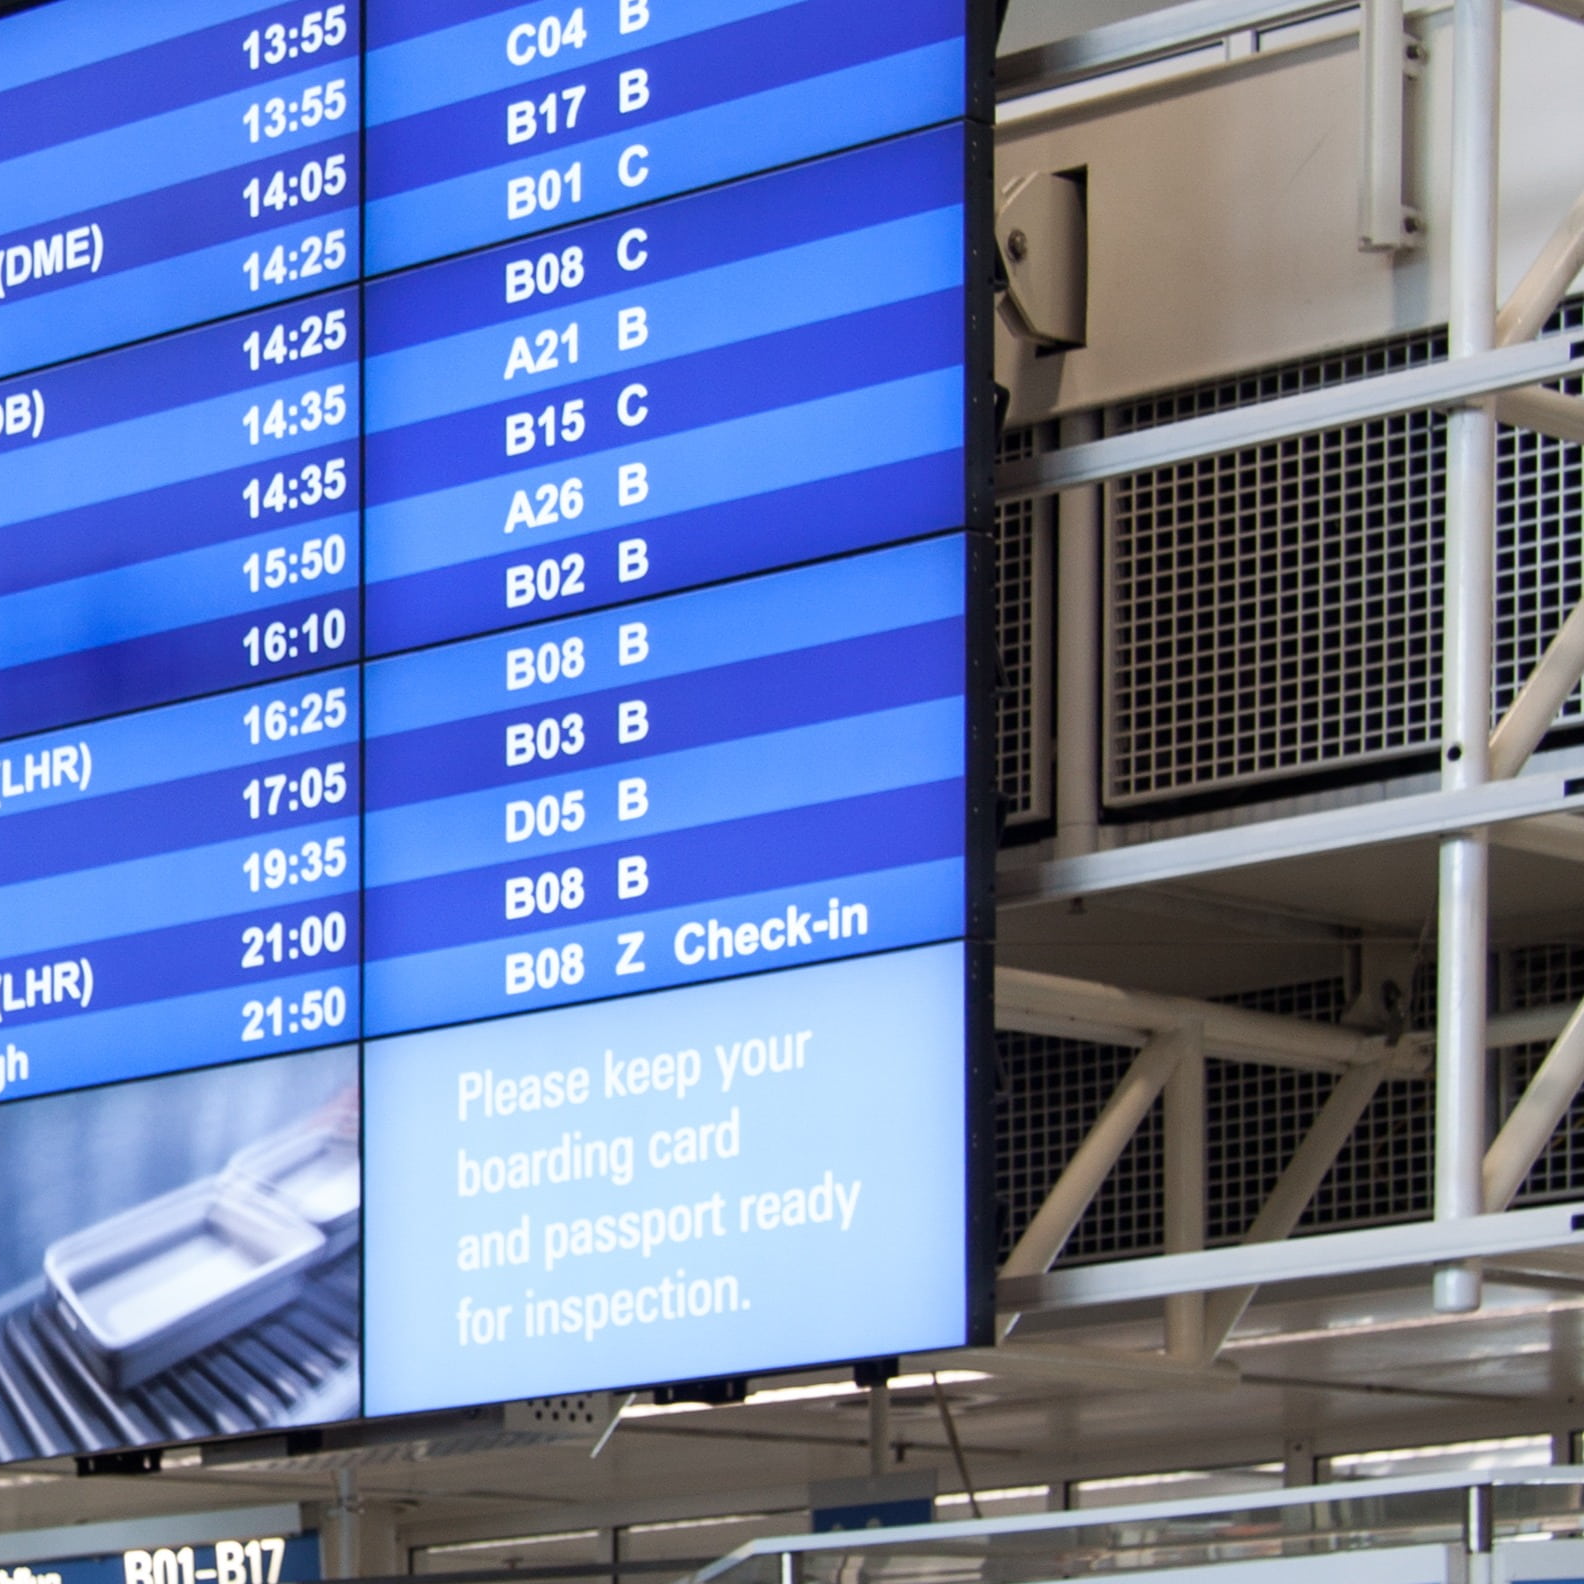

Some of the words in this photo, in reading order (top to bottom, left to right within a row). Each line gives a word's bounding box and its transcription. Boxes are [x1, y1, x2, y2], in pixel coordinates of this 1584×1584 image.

[243, 4, 346, 70] 13:55
[243, 79, 347, 143] 13:55
[506, 7, 587, 66] C04
[243, 154, 346, 218] 14:05
[507, 85, 586, 145] B17
[619, 68, 650, 113] B
[243, 229, 346, 291] 14:25
[507, 162, 581, 220] B01
[618, 144, 649, 187] C
[243, 309, 346, 371] 14:25
[506, 246, 584, 303] B08
[617, 228, 648, 271] C
[242, 384, 346, 445] 14:35
[503, 322, 579, 380] A21
[618, 306, 649, 351] B
[243, 458, 346, 518] 14:35
[506, 399, 585, 456] B15
[617, 383, 648, 427] C
[243, 534, 346, 593] 15:50
[504, 477, 584, 534] A26
[618, 462, 649, 507] B
[243, 609, 345, 666] 16:10
[506, 553, 585, 608] B02
[618, 538, 649, 582] B
[243, 688, 347, 745] 16:25
[506, 636, 585, 691] B08
[619, 622, 649, 666] B
[243, 762, 346, 819] 17:05
[506, 713, 585, 766] B03
[618, 700, 649, 744] B
[243, 836, 347, 892] 19:35
[505, 789, 586, 843] D05
[618, 777, 649, 821] B
[241, 912, 346, 968] 21:00
[505, 867, 585, 920] B08
[618, 855, 649, 899] B
[241, 986, 346, 1042] 21:50
[505, 943, 585, 995] B08
[615, 930, 646, 976] Z
[674, 897, 868, 965] Check-in
[458, 1067, 590, 1121] Please
[604, 1049, 701, 1099] keep
[715, 1030, 812, 1092] your
[458, 1131, 634, 1197] boarding
[648, 1106, 740, 1169] card
[457, 1215, 530, 1271] and
[544, 1192, 726, 1271] passport
[740, 1170, 861, 1233] ready
[457, 1296, 513, 1345] for
[525, 1268, 750, 1341] inspection.
